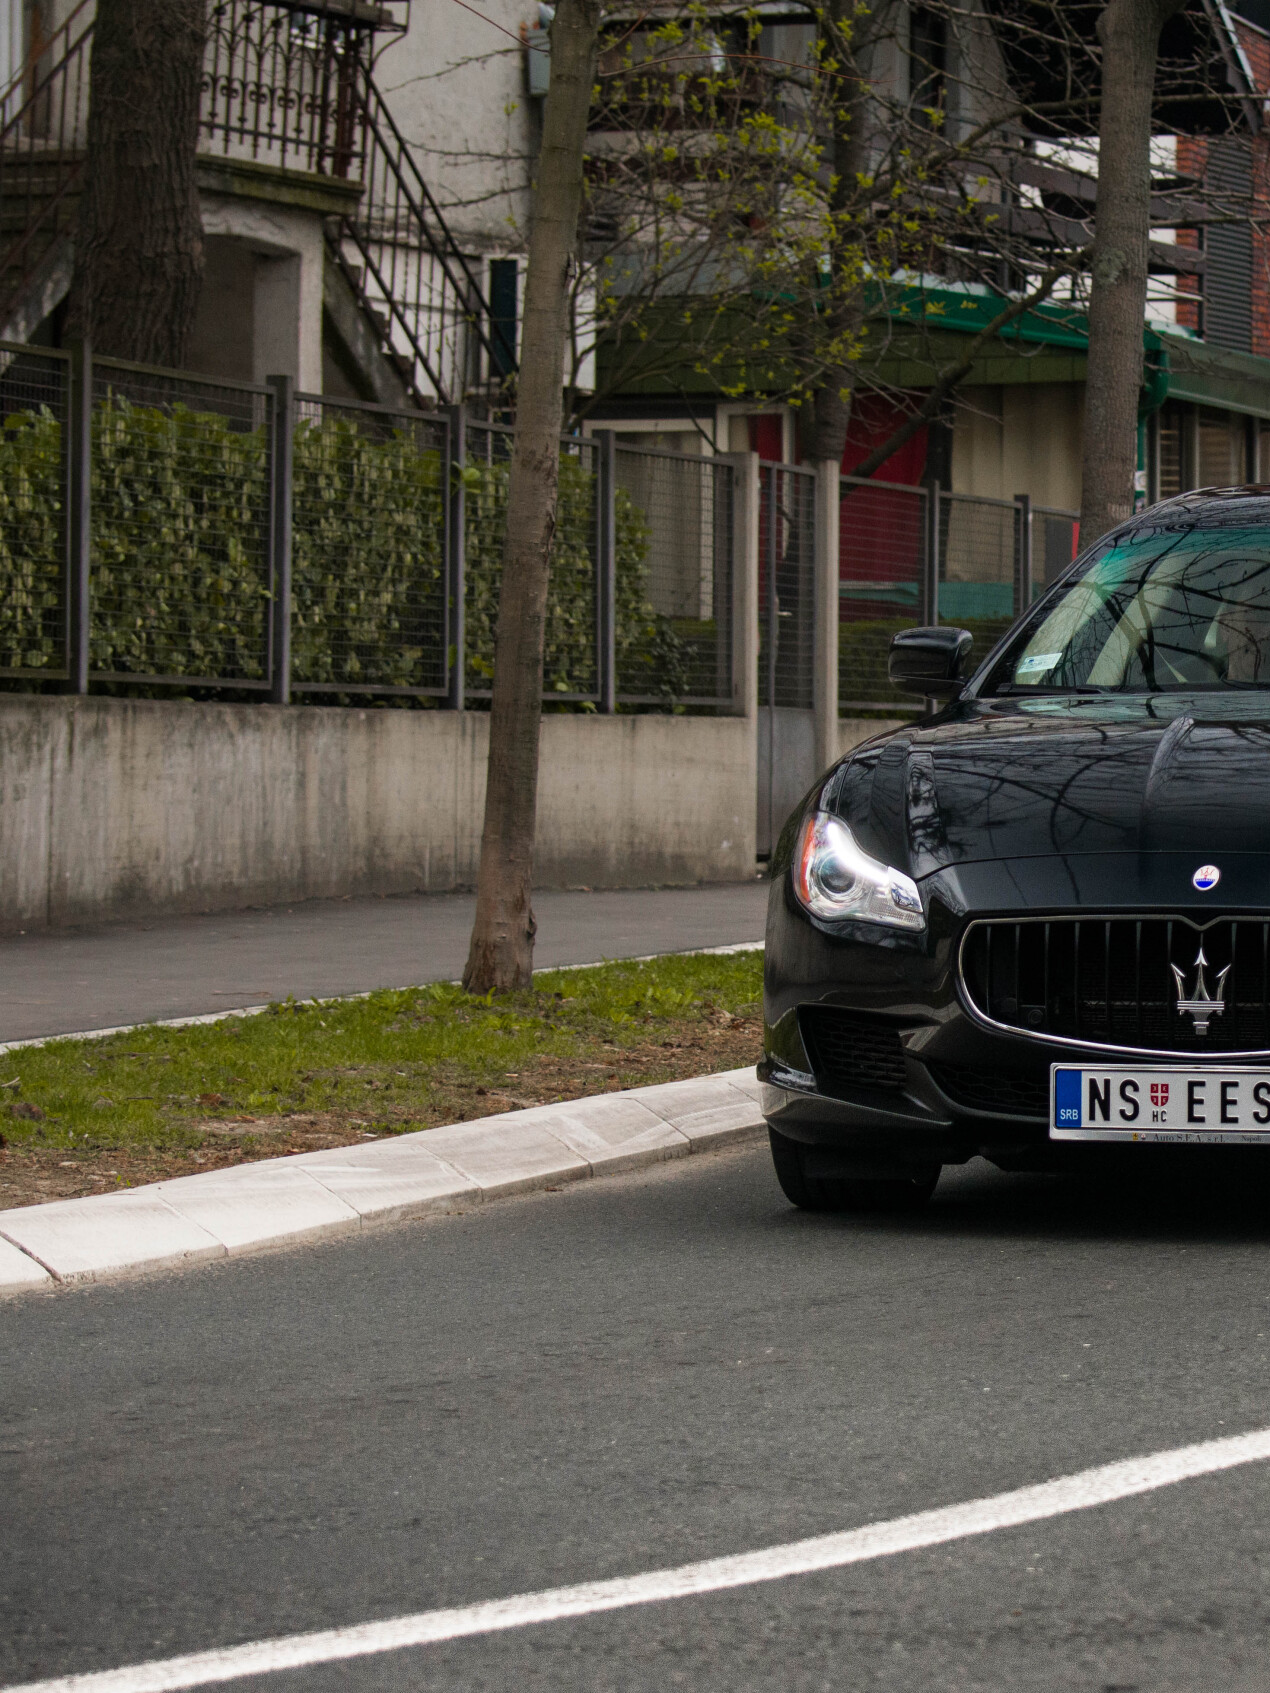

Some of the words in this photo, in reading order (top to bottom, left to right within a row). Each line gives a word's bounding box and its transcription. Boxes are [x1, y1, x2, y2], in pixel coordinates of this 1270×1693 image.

[1089, 1077, 1139, 1121] NS
[1060, 1108, 1079, 1120] SRB
[1153, 1133, 1174, 1142] Auto
